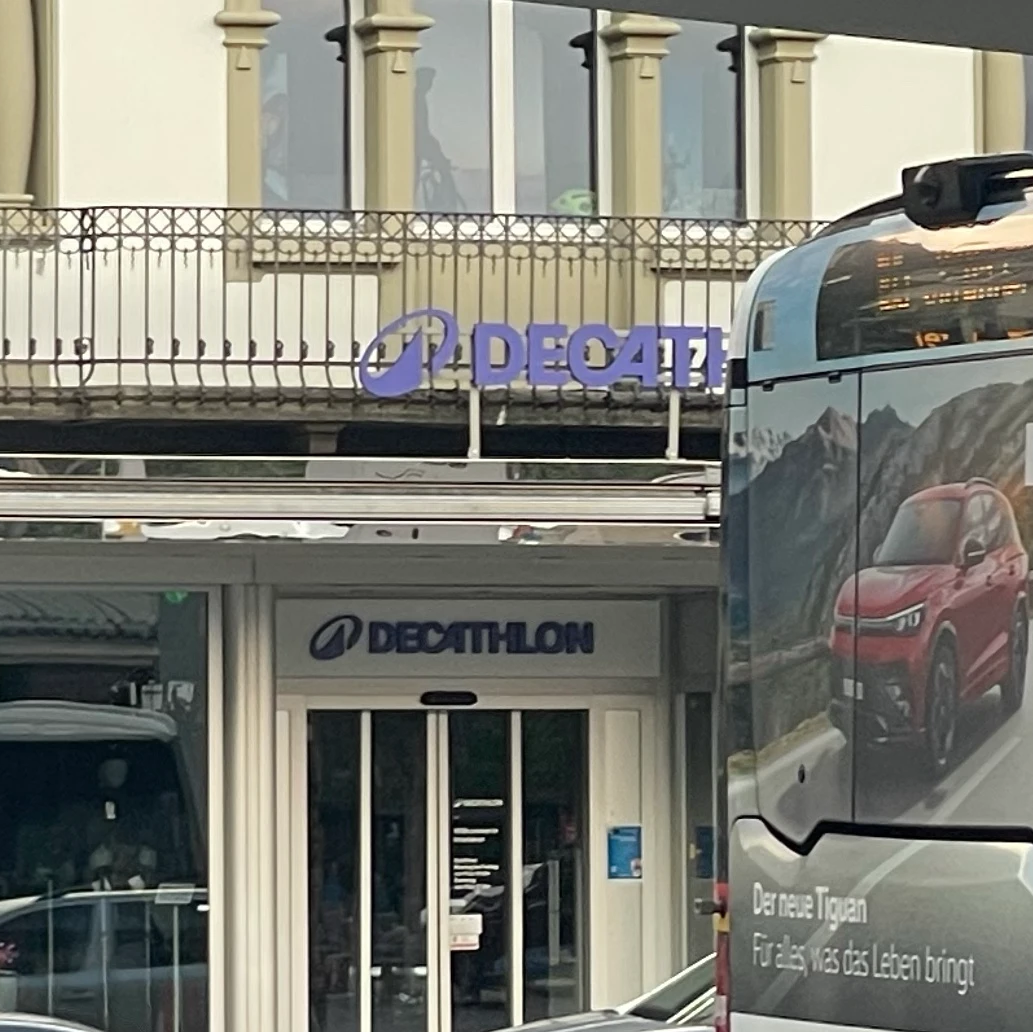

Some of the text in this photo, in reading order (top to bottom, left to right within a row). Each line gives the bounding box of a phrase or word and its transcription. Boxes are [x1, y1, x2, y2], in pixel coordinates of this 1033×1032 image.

[368, 621, 595, 654] DECATHLON
[753, 882, 868, 931] Der neue Tiguan
[753, 932, 775, 967] Für
[811, 946, 840, 975] was
[842, 939, 869, 977] das
[873, 943, 922, 981] Leben
[925, 945, 976, 995] bringt
